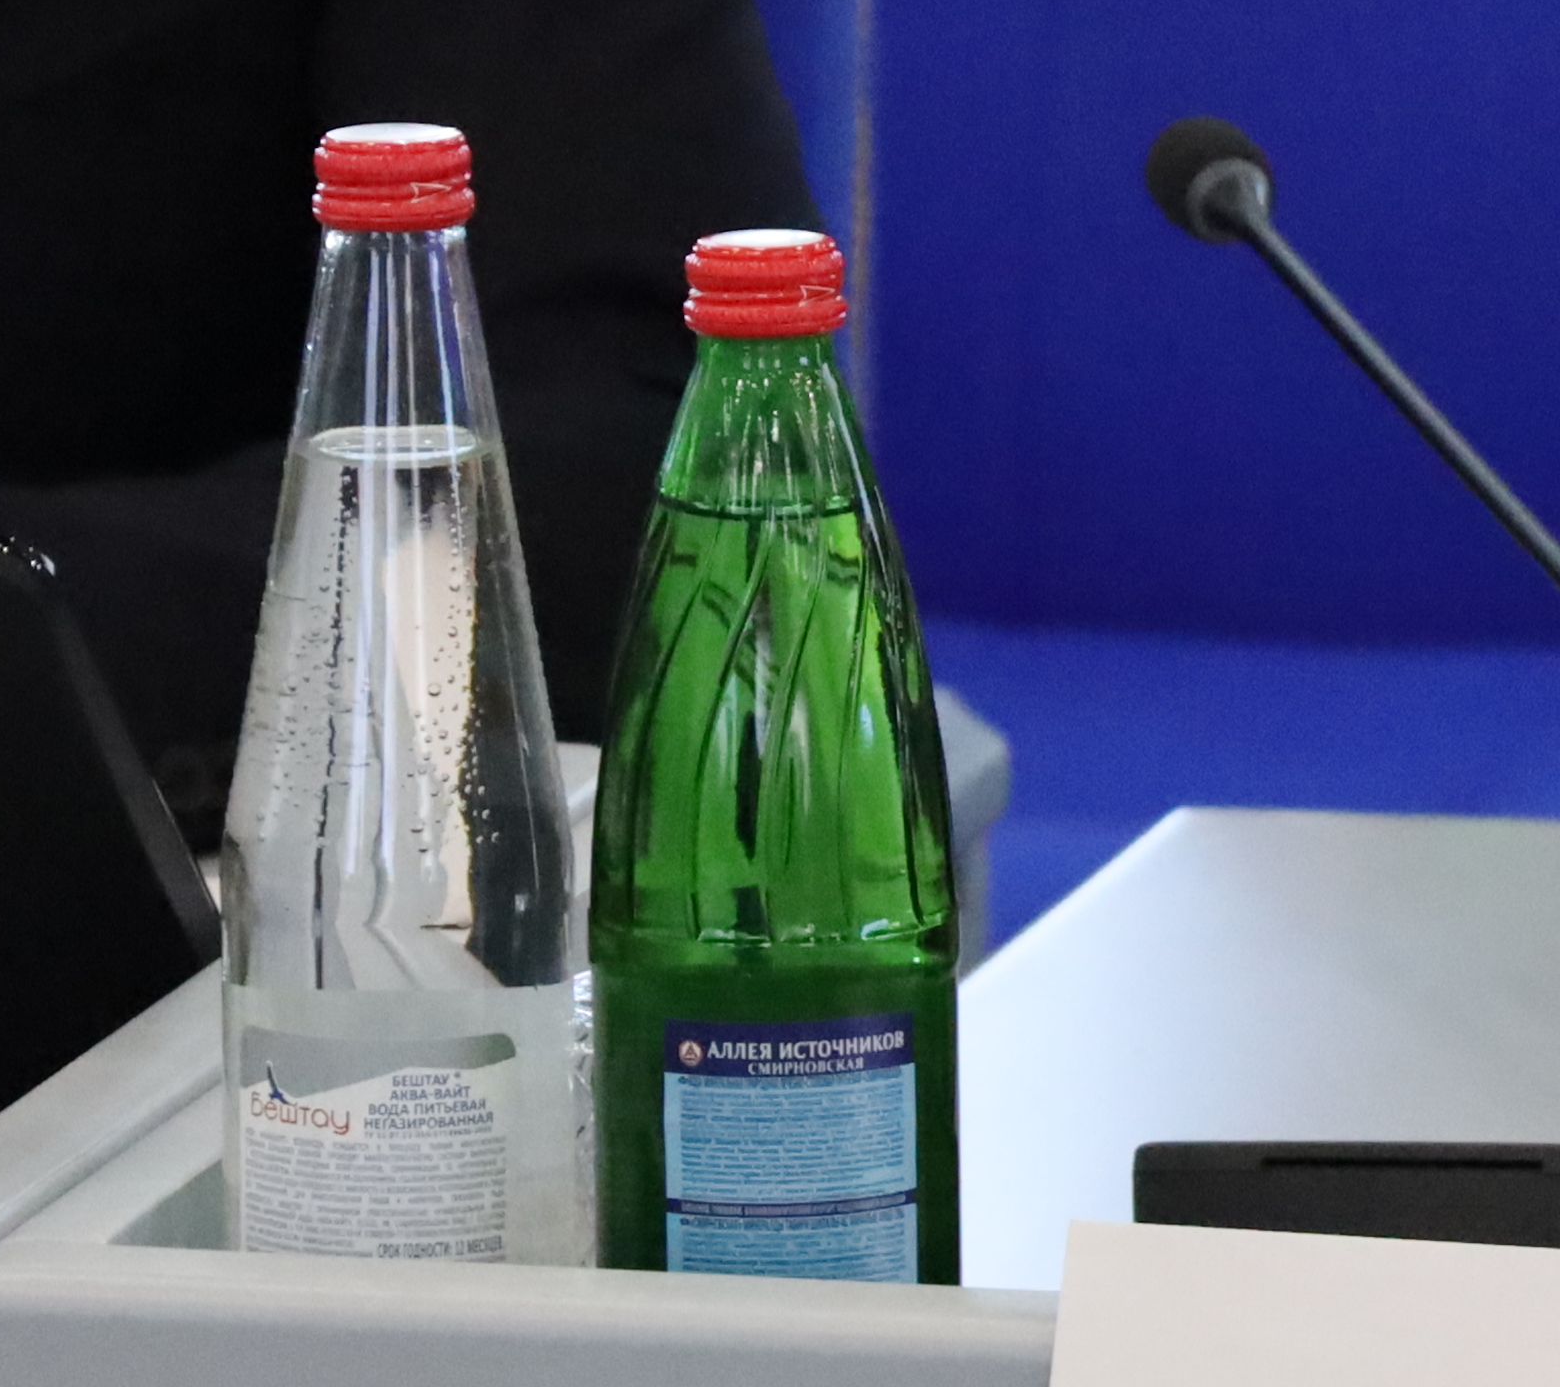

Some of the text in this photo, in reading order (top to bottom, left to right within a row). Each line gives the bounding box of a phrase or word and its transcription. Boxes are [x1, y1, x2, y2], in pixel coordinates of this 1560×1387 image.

[706, 1030, 905, 1060] АЛЛЕЯ ИСТОЧНИКОВ
[747, 1056, 864, 1075] СМИРНОВСКАЯ
[389, 1084, 471, 1101] АКВА-ВАЙТ
[368, 1098, 487, 1118] ВОДА ПИТЬЕВАЯ
[363, 1110, 494, 1130] НЕГАЗИРОВАННАЯ
